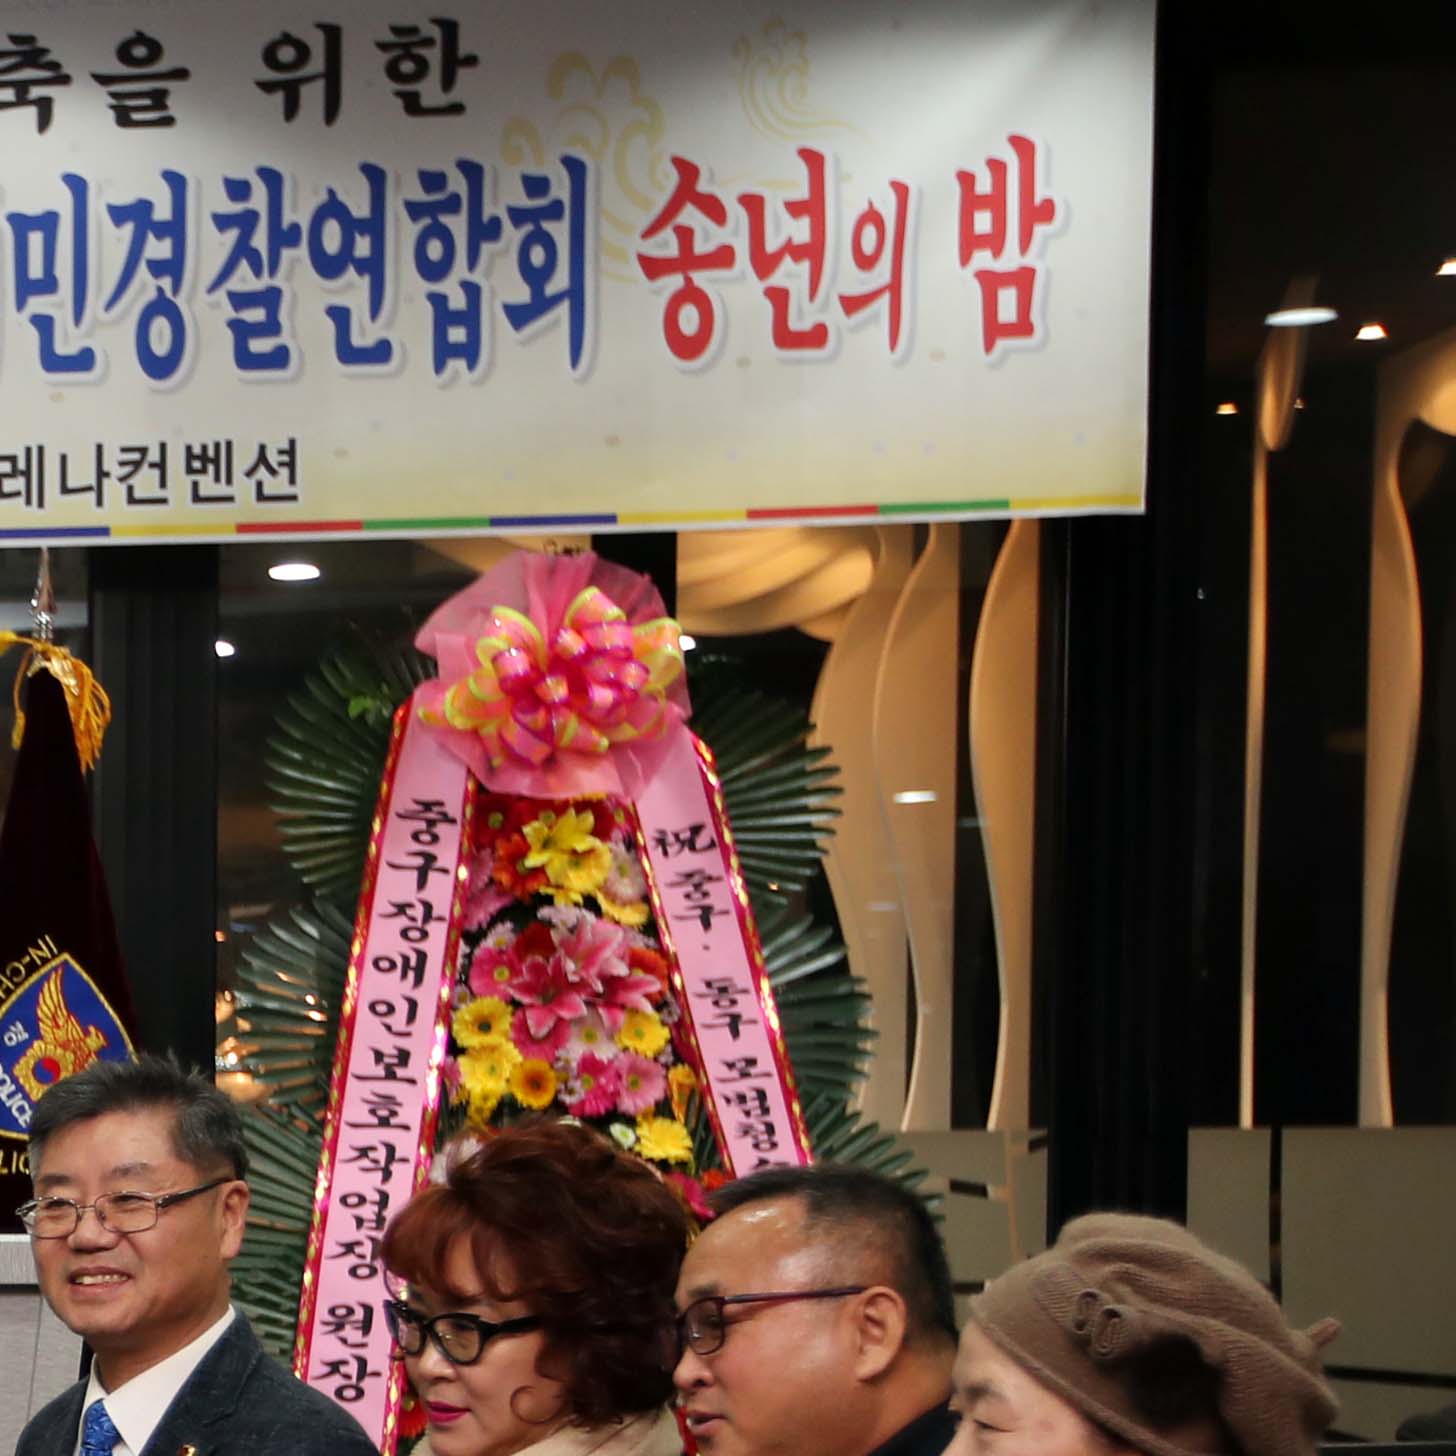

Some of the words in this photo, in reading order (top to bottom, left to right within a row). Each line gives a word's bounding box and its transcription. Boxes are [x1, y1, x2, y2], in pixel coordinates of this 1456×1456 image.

[253, 17, 481, 127] 위한
[637, 148, 909, 361] 송년의
[956, 135, 1055, 353] 밤
[653, 823, 718, 857] 祝
[693, 976, 759, 1042] 동구
[312, 1301, 383, 1402] 원장
